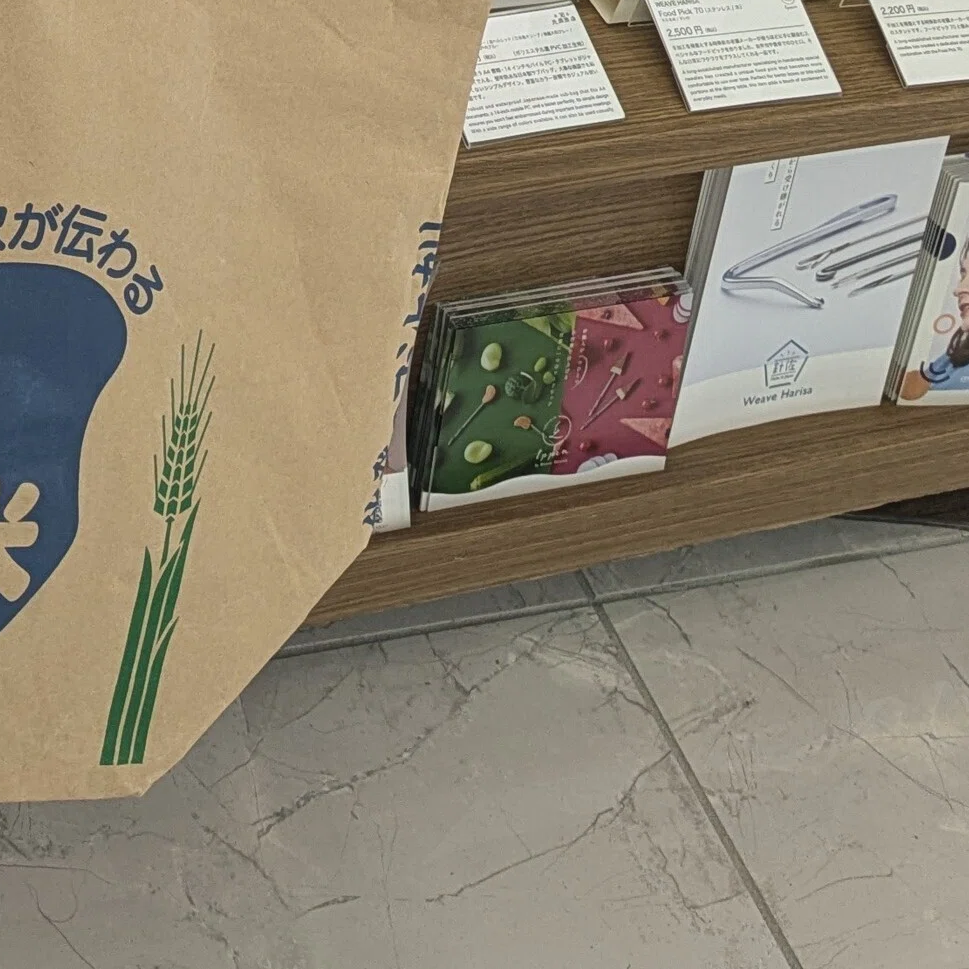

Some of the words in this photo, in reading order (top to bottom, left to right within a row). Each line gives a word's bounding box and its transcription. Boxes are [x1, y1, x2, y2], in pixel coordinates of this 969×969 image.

[655, 0, 676, 8] WEAVE
[880, 5, 906, 16] 2,200
[907, 4, 916, 13] 円
[658, 8, 676, 17] Food
[678, 7, 692, 16] Pick
[694, 6, 704, 14] 70
[666, 26, 693, 37] 2,500
[694, 25, 704, 35] 円
[742, 393, 777, 406] Weave
[780, 387, 813, 401] Harisa
